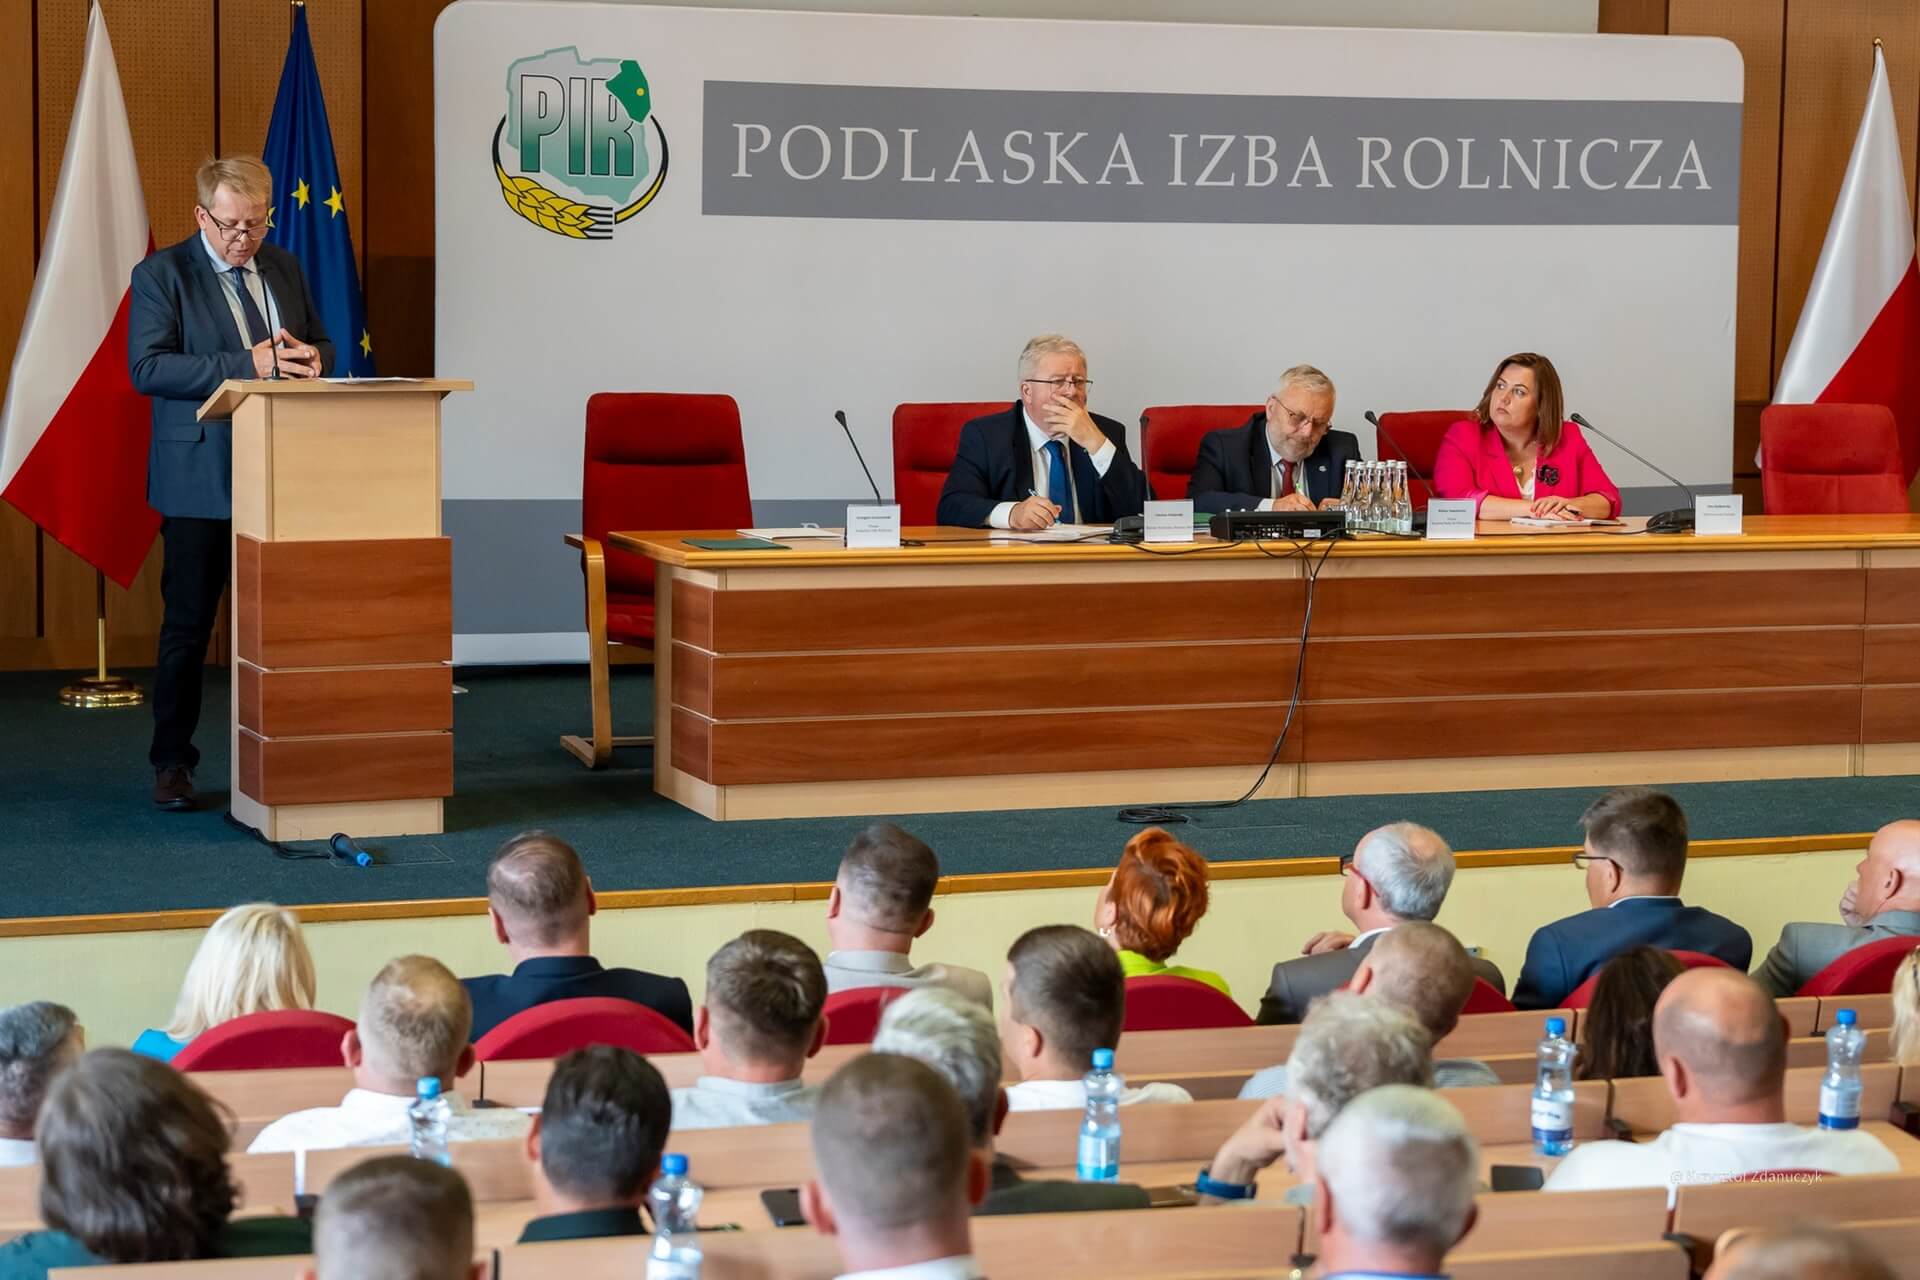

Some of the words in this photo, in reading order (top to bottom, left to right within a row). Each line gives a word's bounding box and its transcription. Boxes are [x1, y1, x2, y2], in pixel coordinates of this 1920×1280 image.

[520, 74, 635, 177] PIR
[731, 123, 1144, 186] PODLASKA
[1167, 134, 1333, 189] IZBA
[1356, 137, 1712, 191] ROLNICZA
